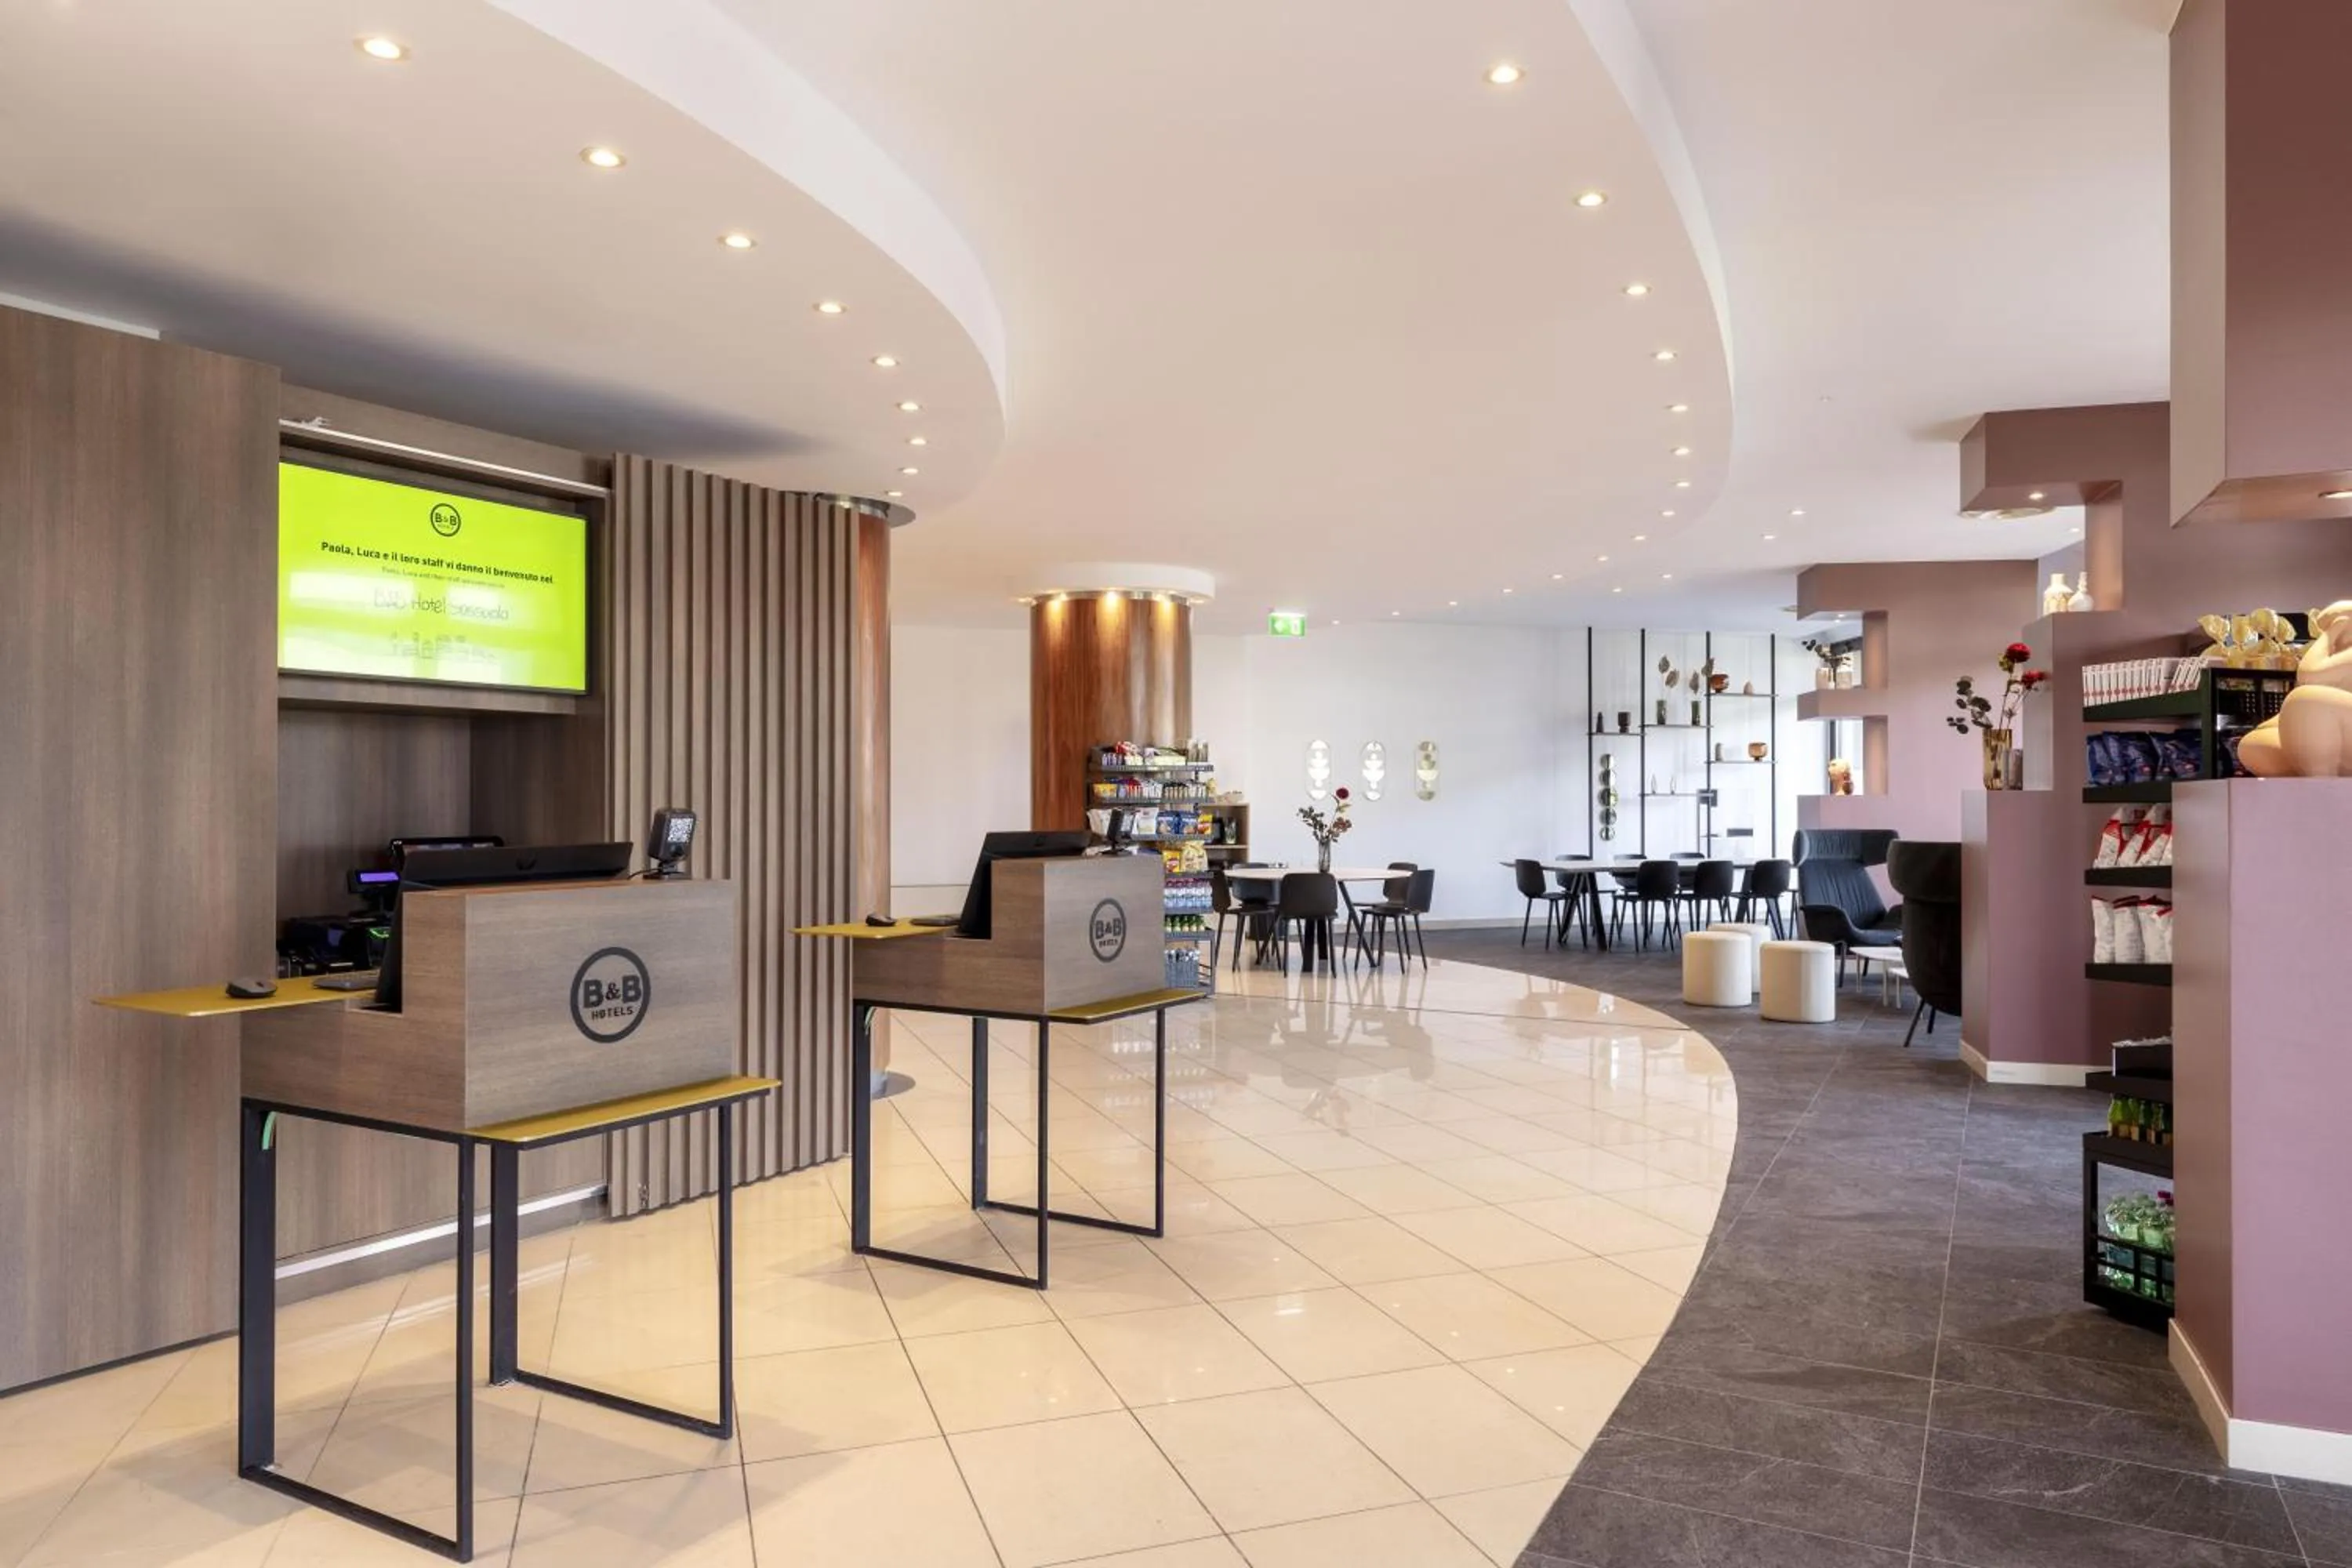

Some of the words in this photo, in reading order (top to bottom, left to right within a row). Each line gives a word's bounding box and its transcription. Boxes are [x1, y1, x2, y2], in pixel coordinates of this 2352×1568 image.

[435, 513, 457, 525] B&B
[321, 542, 354, 556] Paola,
[357, 546, 380, 559] Luca
[391, 552, 397, 561] il
[401, 554, 420, 564] loro
[422, 557, 444, 568] staff
[445, 560, 454, 569] vi
[456, 562, 484, 573] danno
[485, 565, 492, 575] il
[493, 567, 539, 582] benvenuto
[412, 592, 446, 614] Hotel
[1095, 920, 1122, 939] B&B
[583, 975, 641, 1008] B&B
[591, 1007, 633, 1021] HOTELS
